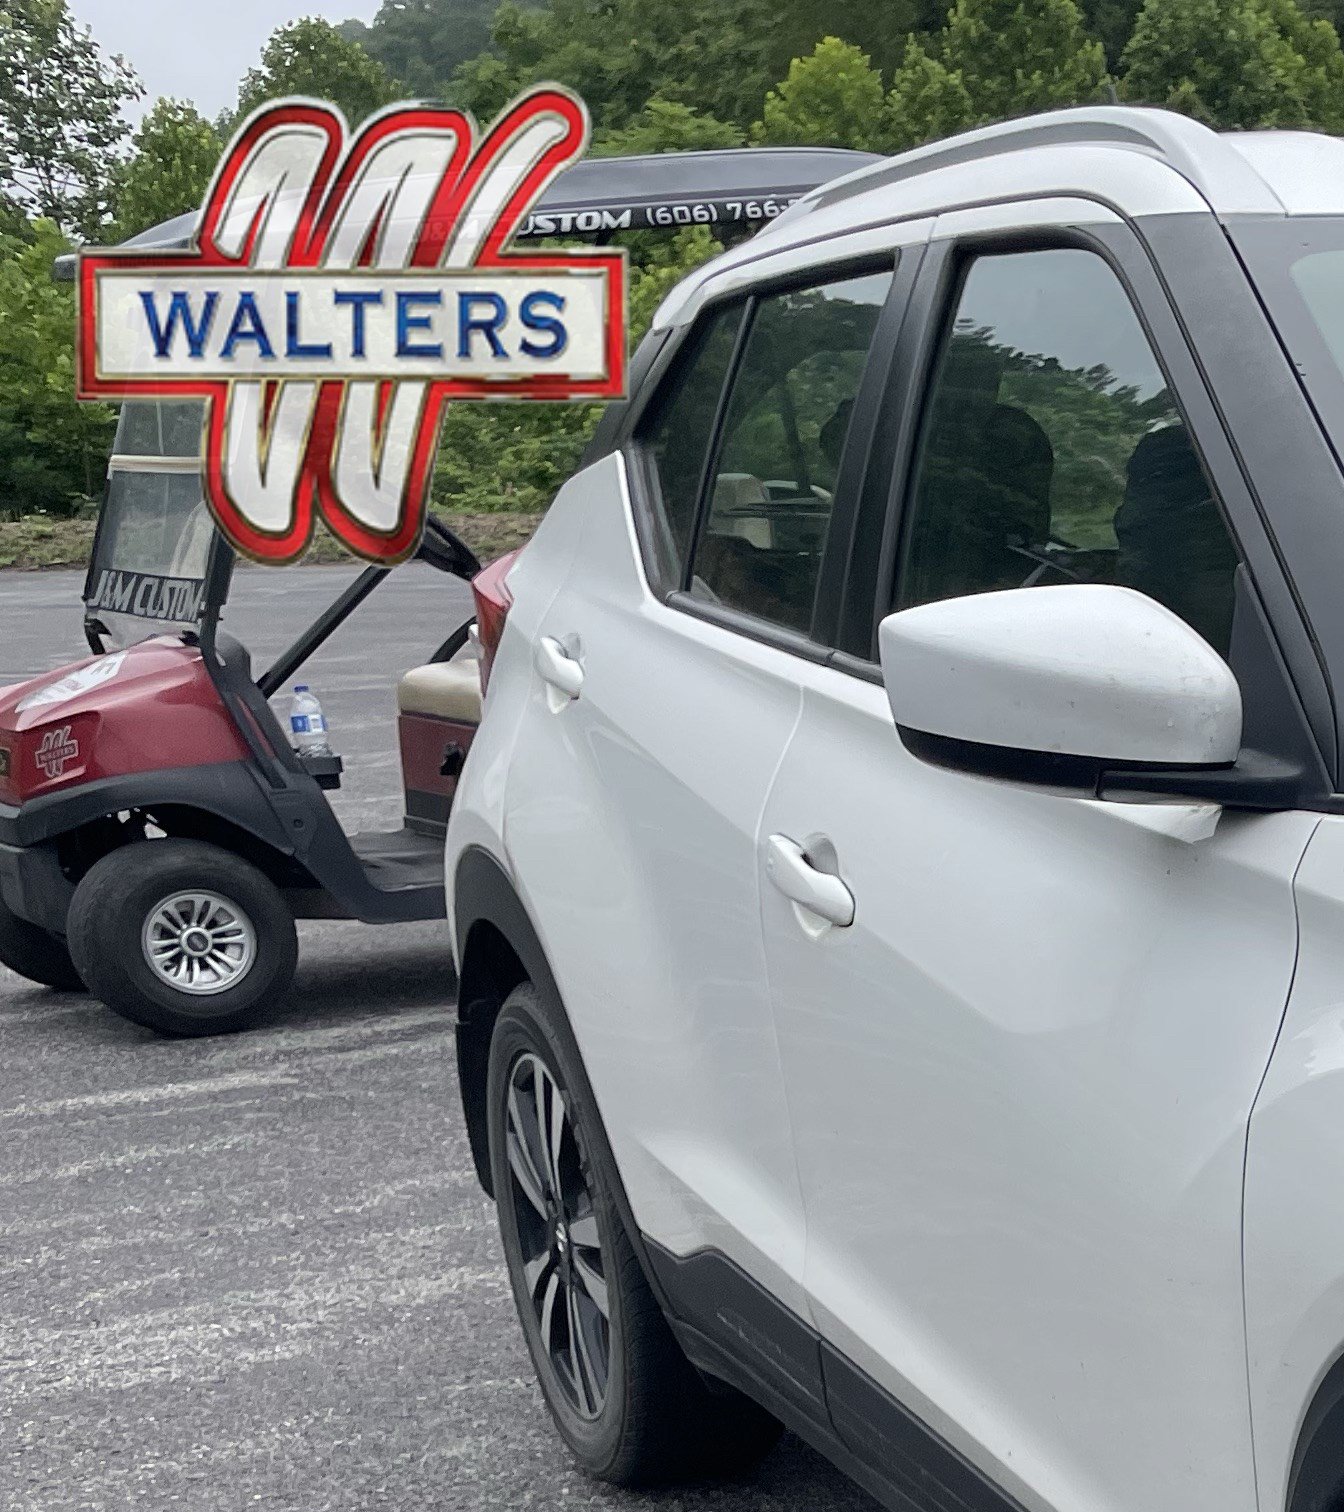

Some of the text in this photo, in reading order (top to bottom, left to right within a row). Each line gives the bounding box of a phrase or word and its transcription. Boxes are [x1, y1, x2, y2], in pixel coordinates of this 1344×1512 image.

[517, 209, 632, 235] USTOM
[645, 205, 718, 226] (606)
[726, 199, 798, 220] 766-
[132, 576, 206, 624] CUSTOM
